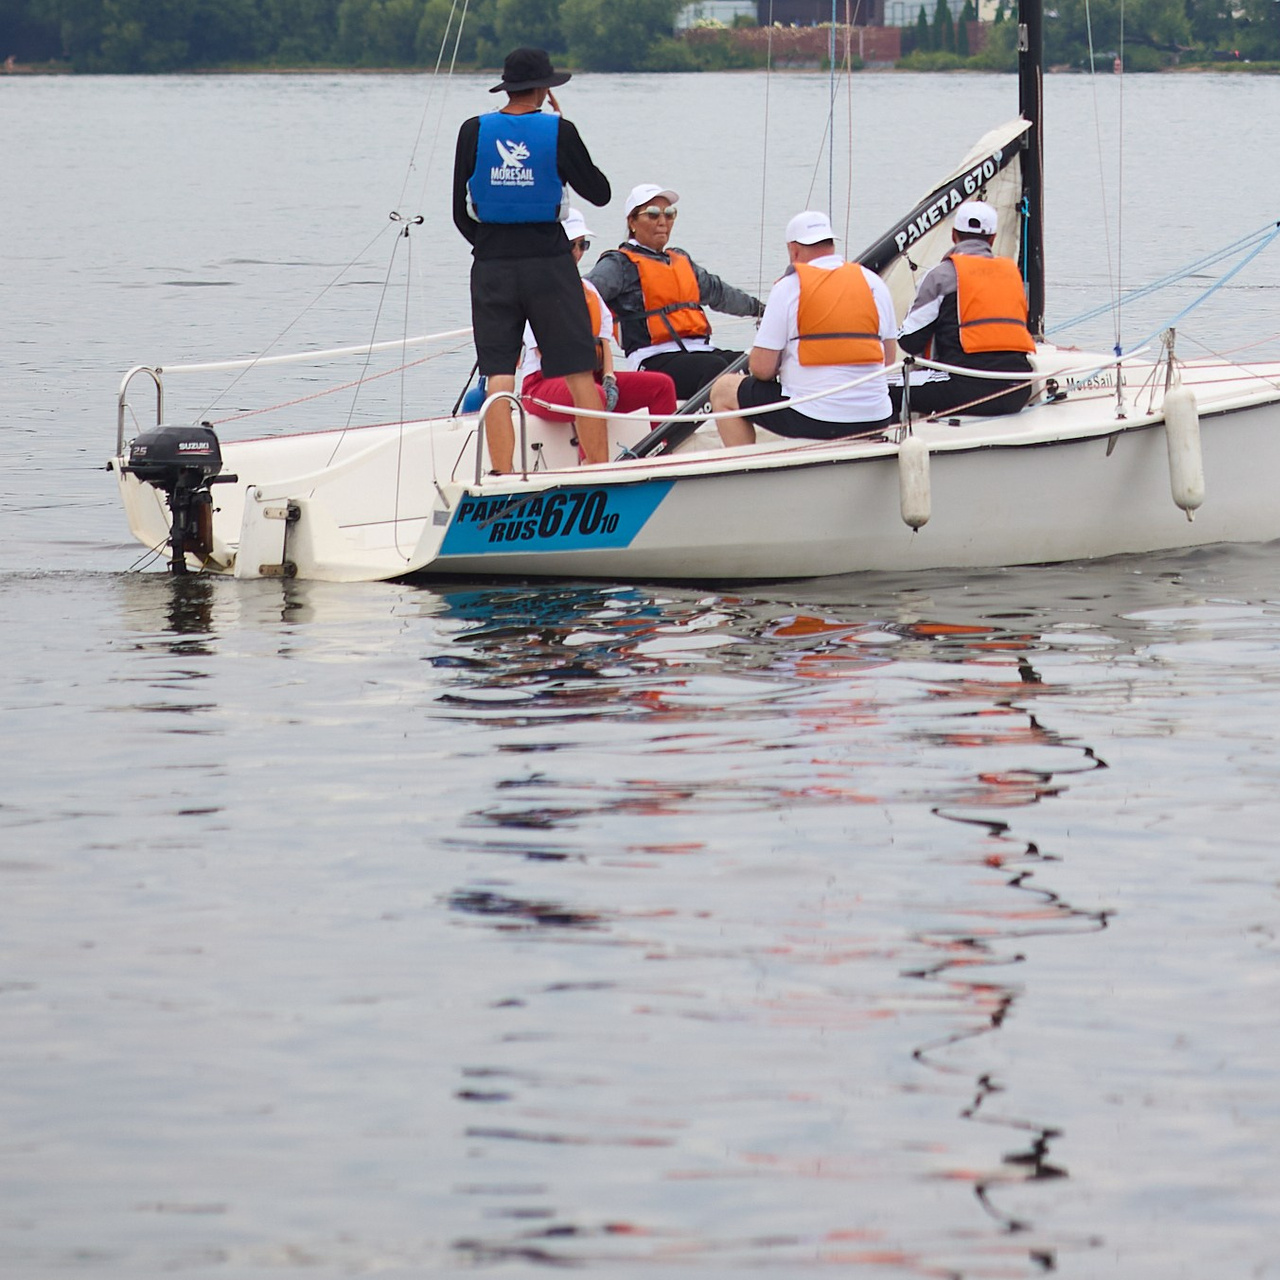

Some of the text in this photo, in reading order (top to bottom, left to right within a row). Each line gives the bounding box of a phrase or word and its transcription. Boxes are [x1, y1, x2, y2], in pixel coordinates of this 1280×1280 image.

[490, 167, 534, 181] MORESAIL
[963, 160, 995, 195] 670
[178, 442, 209, 450] SUZUKI
[537, 490, 620, 539] 670 10
[488, 519, 538, 543] RUS
